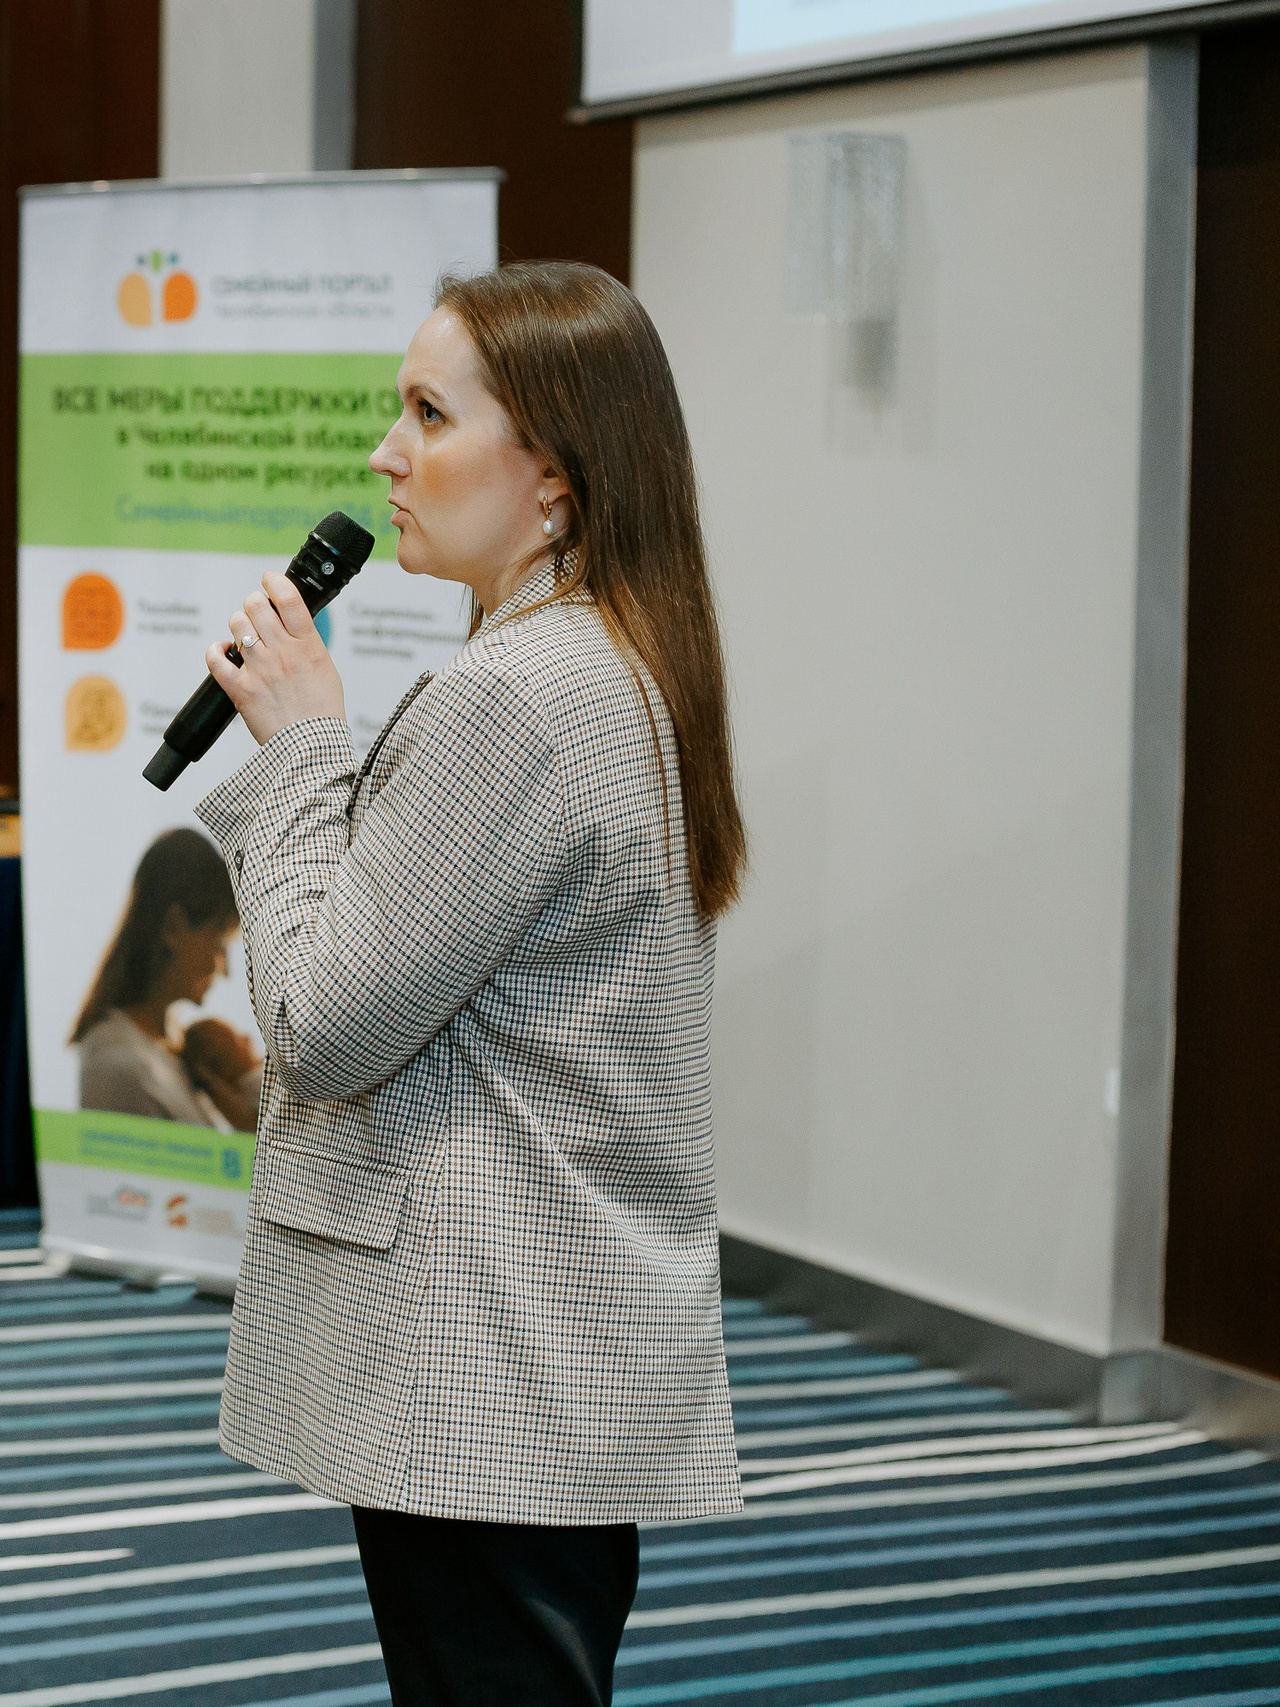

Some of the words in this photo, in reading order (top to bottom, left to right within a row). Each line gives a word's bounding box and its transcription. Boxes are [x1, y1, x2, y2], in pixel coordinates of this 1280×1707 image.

[53, 386, 98, 414] ВСЕ
[107, 386, 183, 415] МЕРЫ
[190, 386, 370, 417] ПОДДЕРЖКИ
